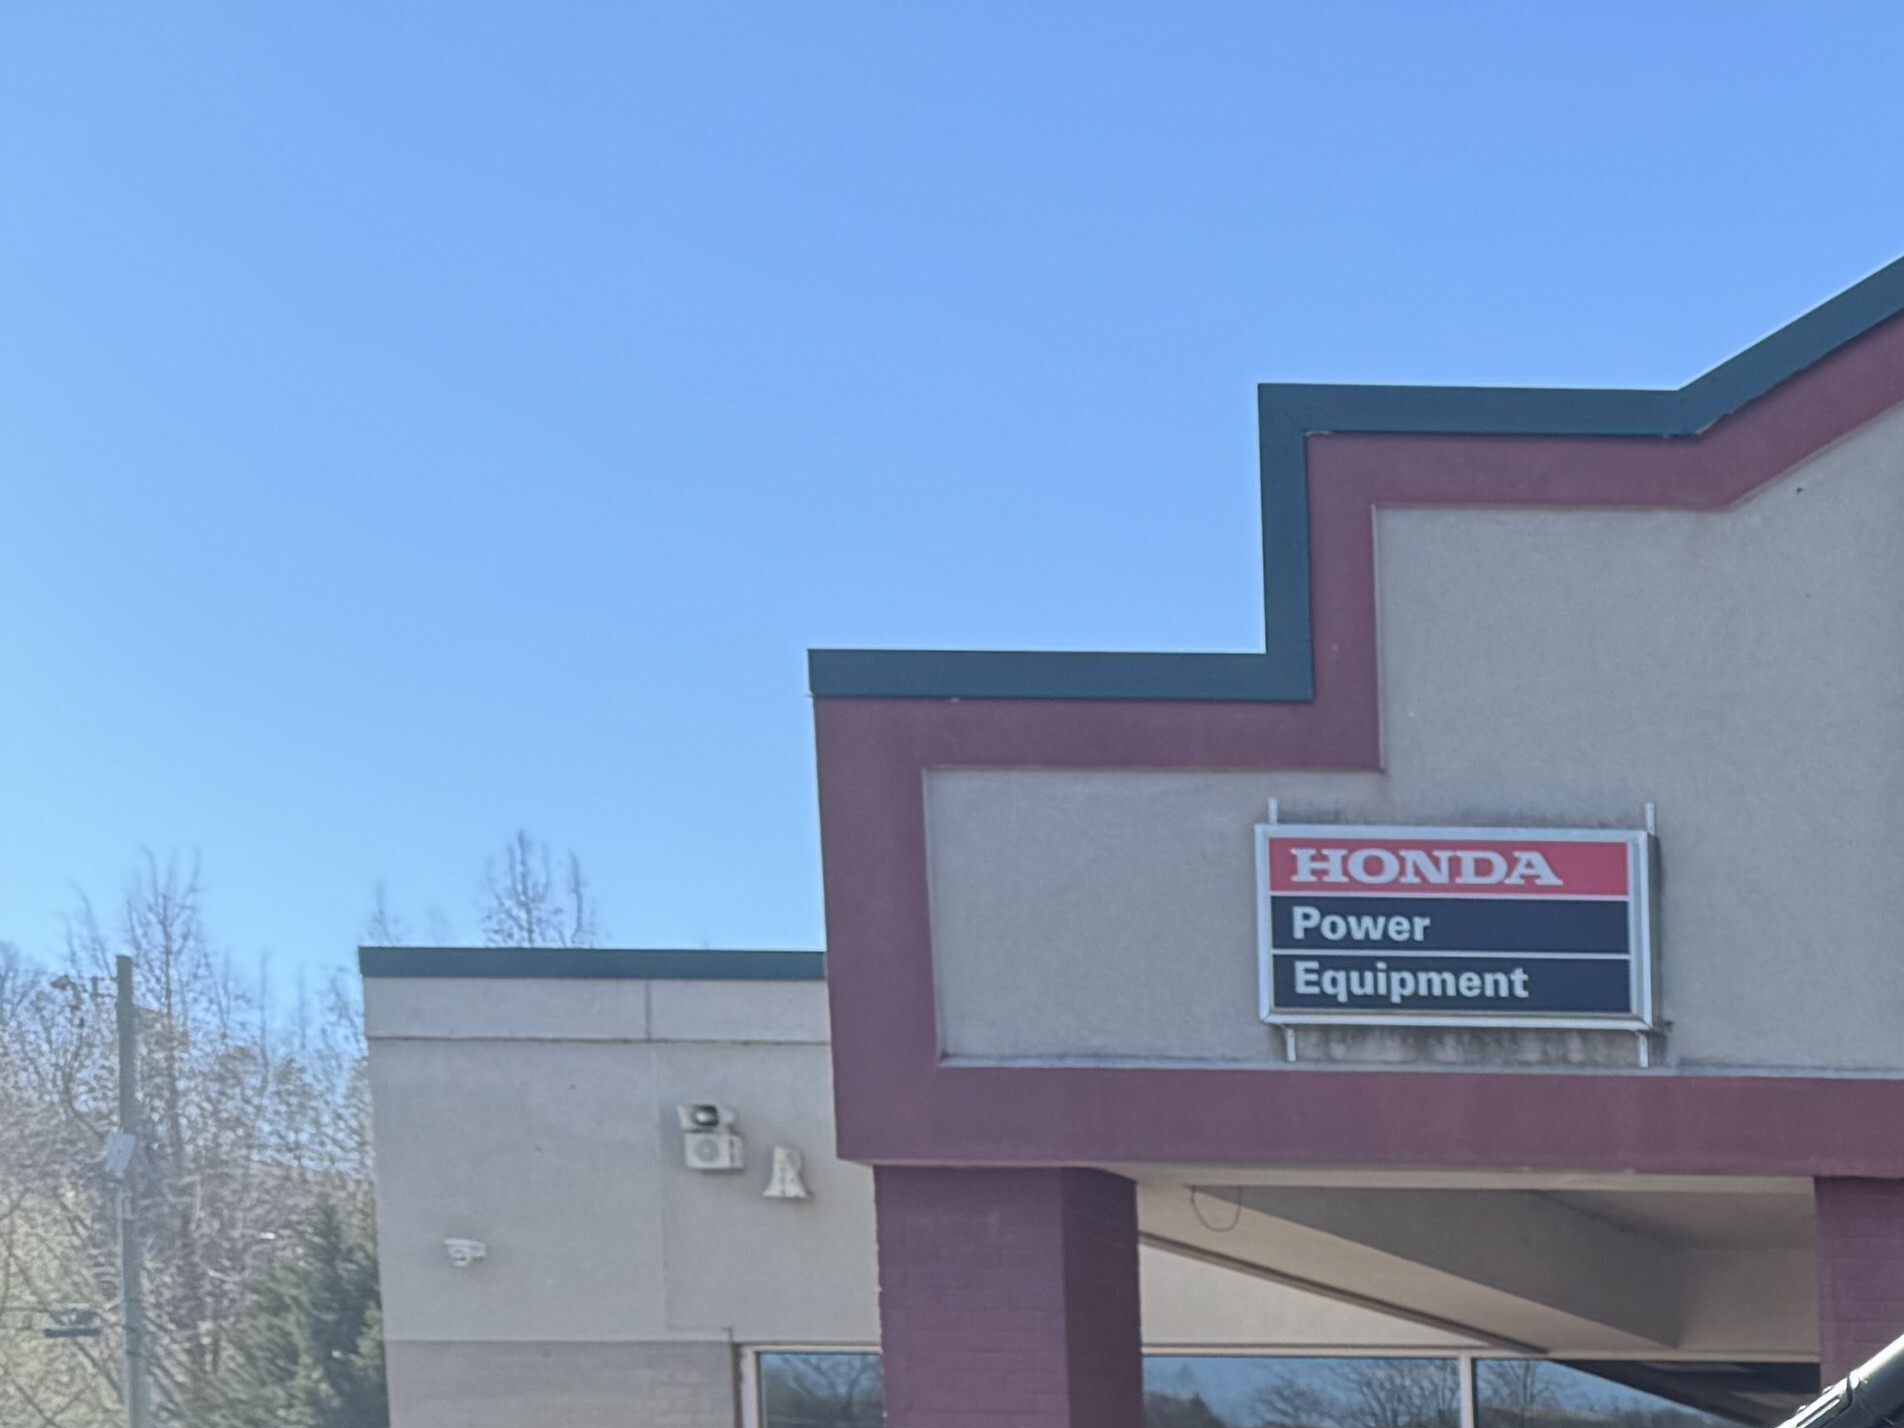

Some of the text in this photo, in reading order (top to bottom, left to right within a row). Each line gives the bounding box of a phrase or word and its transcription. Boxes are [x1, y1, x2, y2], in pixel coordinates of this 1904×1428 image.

[1290, 848, 1563, 887] HONDA
[1293, 906, 1430, 942] Power
[1294, 961, 1529, 1003] Equipment
